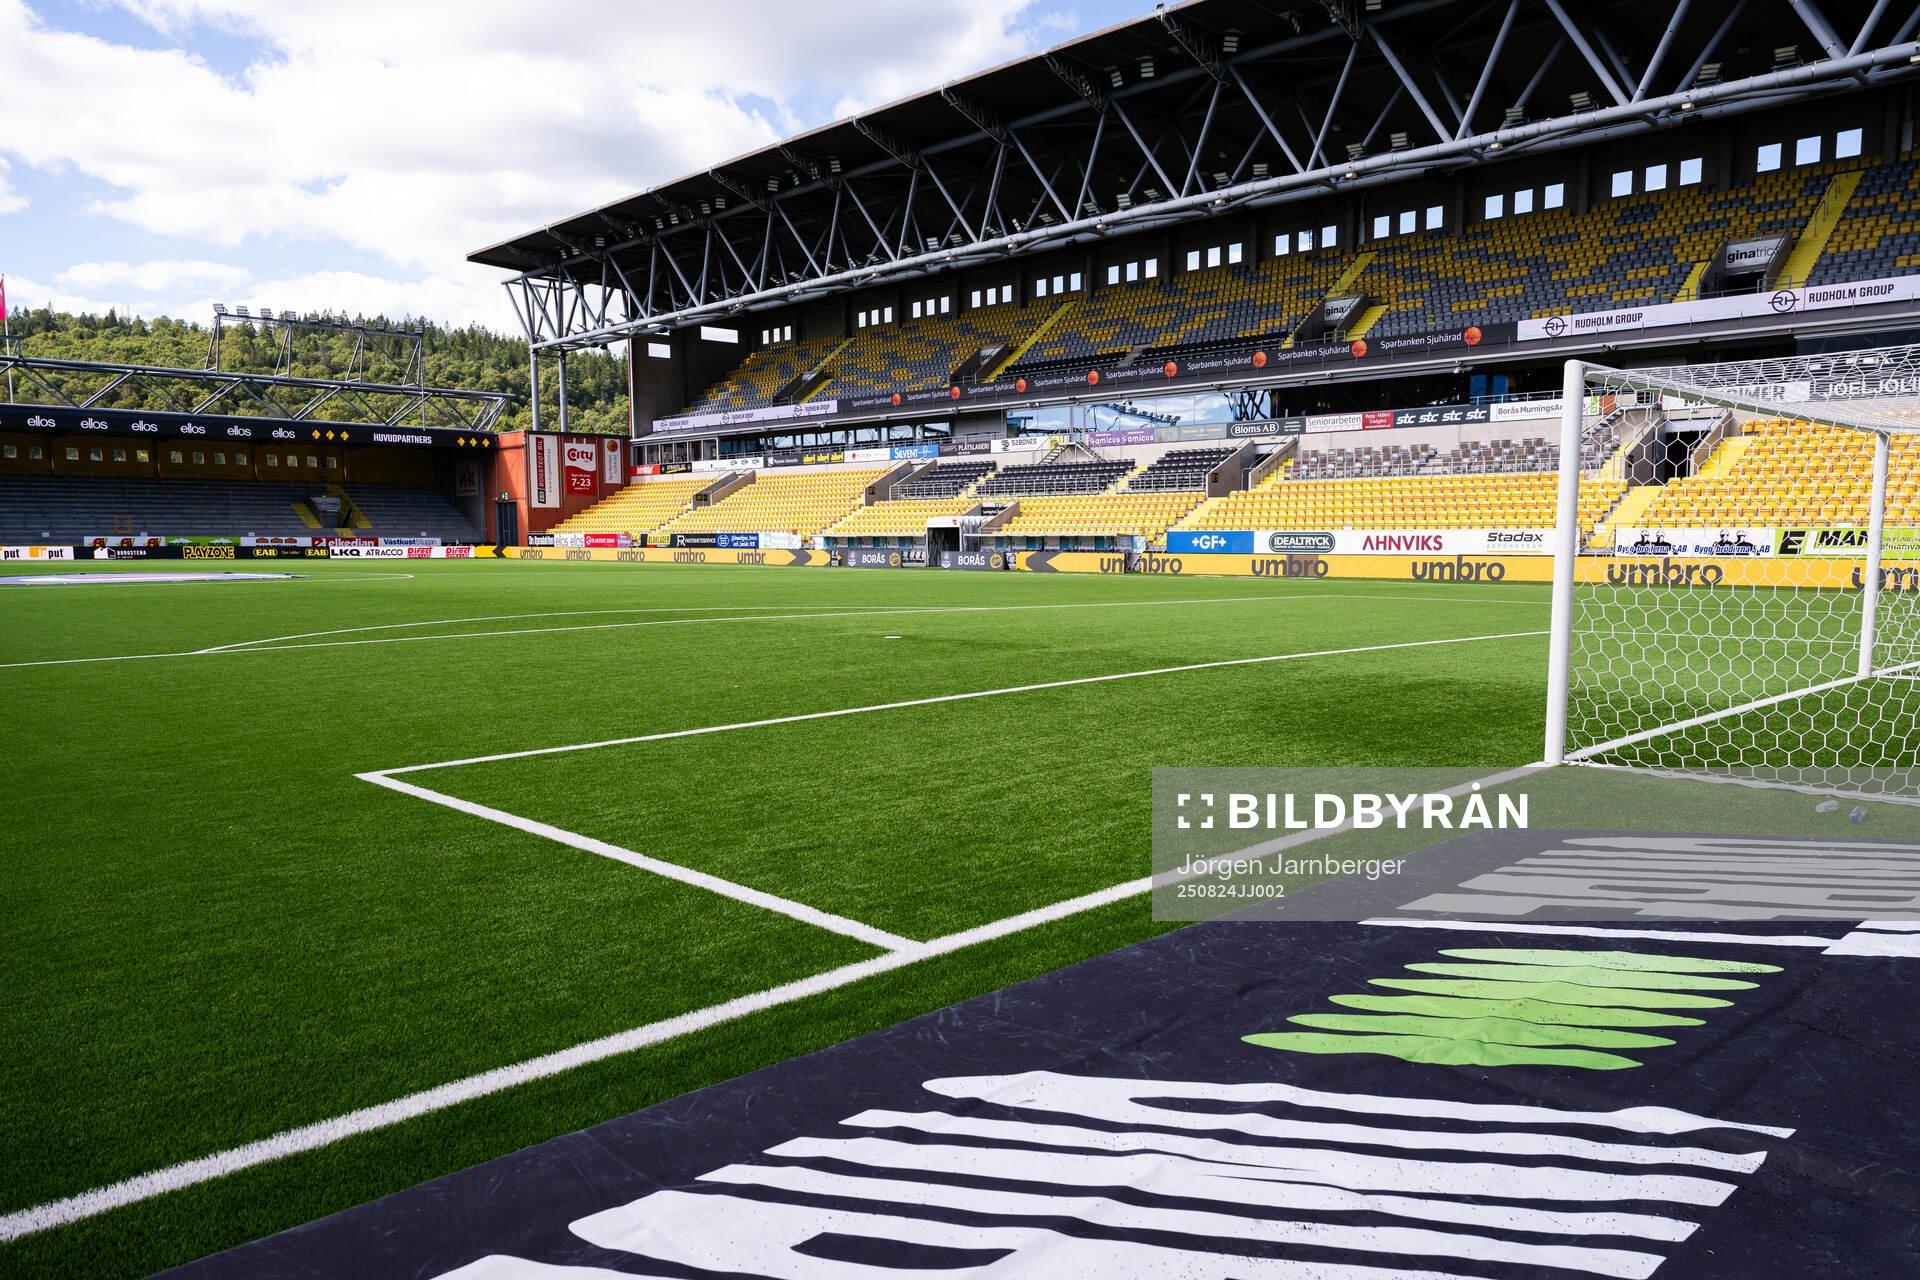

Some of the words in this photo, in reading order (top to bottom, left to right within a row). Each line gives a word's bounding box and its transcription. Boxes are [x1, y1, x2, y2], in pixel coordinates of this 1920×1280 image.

[1809, 288, 1856, 303] RUDHOLM
[1859, 284, 1894, 298] GROUP
[1575, 314, 1613, 328] RUDHOLM
[1615, 313, 1643, 325] GROUP
[1380, 338, 1425, 350] Sparbanken
[1426, 333, 1461, 346] Sjuhärad
[1278, 350, 1317, 361] Sparbanken
[1318, 346, 1349, 358] Sjuhärad
[1187, 360, 1223, 370] Sparbanken
[1224, 356, 1251, 368] Sjuhärad
[1106, 370, 1138, 380] Sparbanken
[1139, 366, 1163, 378] Sjuhärad
[1034, 377, 1064, 387] Sparbanken
[968, 386, 994, 395] Sparbanken
[1442, 410, 1461, 422] stc
[1465, 408, 1487, 421] stc
[1498, 406, 1519, 415] Borås
[27, 415, 56, 427] ellos
[1307, 415, 1361, 427] Seniorarbeten
[1396, 413, 1415, 425] stc
[1418, 411, 1438, 423] stc
[80, 418, 108, 430] ellos
[131, 420, 158, 433] ellos
[180, 423, 206, 434] ellos
[1234, 425, 1261, 434] Bloms
[1262, 423, 1276, 433] AB
[227, 425, 252, 437] ellos
[272, 428, 295, 439] ellos
[373, 433, 432, 444] HUVUDPARTNERS
[1095, 437, 1120, 445] amicus
[1127, 435, 1154, 444] amicus
[571, 478, 591, 487] 7-23
[1274, 536, 1330, 546] IDEALTRYCK
[1362, 535, 1443, 551] AHNVIKS
[1487, 532, 1544, 542] Stadax
[183, 546, 235, 560] PLAYZONE
[331, 549, 360, 557] LKQ
[520, 547, 543, 560] umbro
[566, 547, 592, 561] umbro
[617, 548, 645, 562] umbro
[674, 549, 706, 563] umbro
[862, 552, 886, 565] BORÅS
[958, 554, 986, 567] BORÅS
[1252, 554, 1328, 578] umbro
[1412, 555, 1505, 581] umbro
[1607, 557, 1724, 586] umbro
